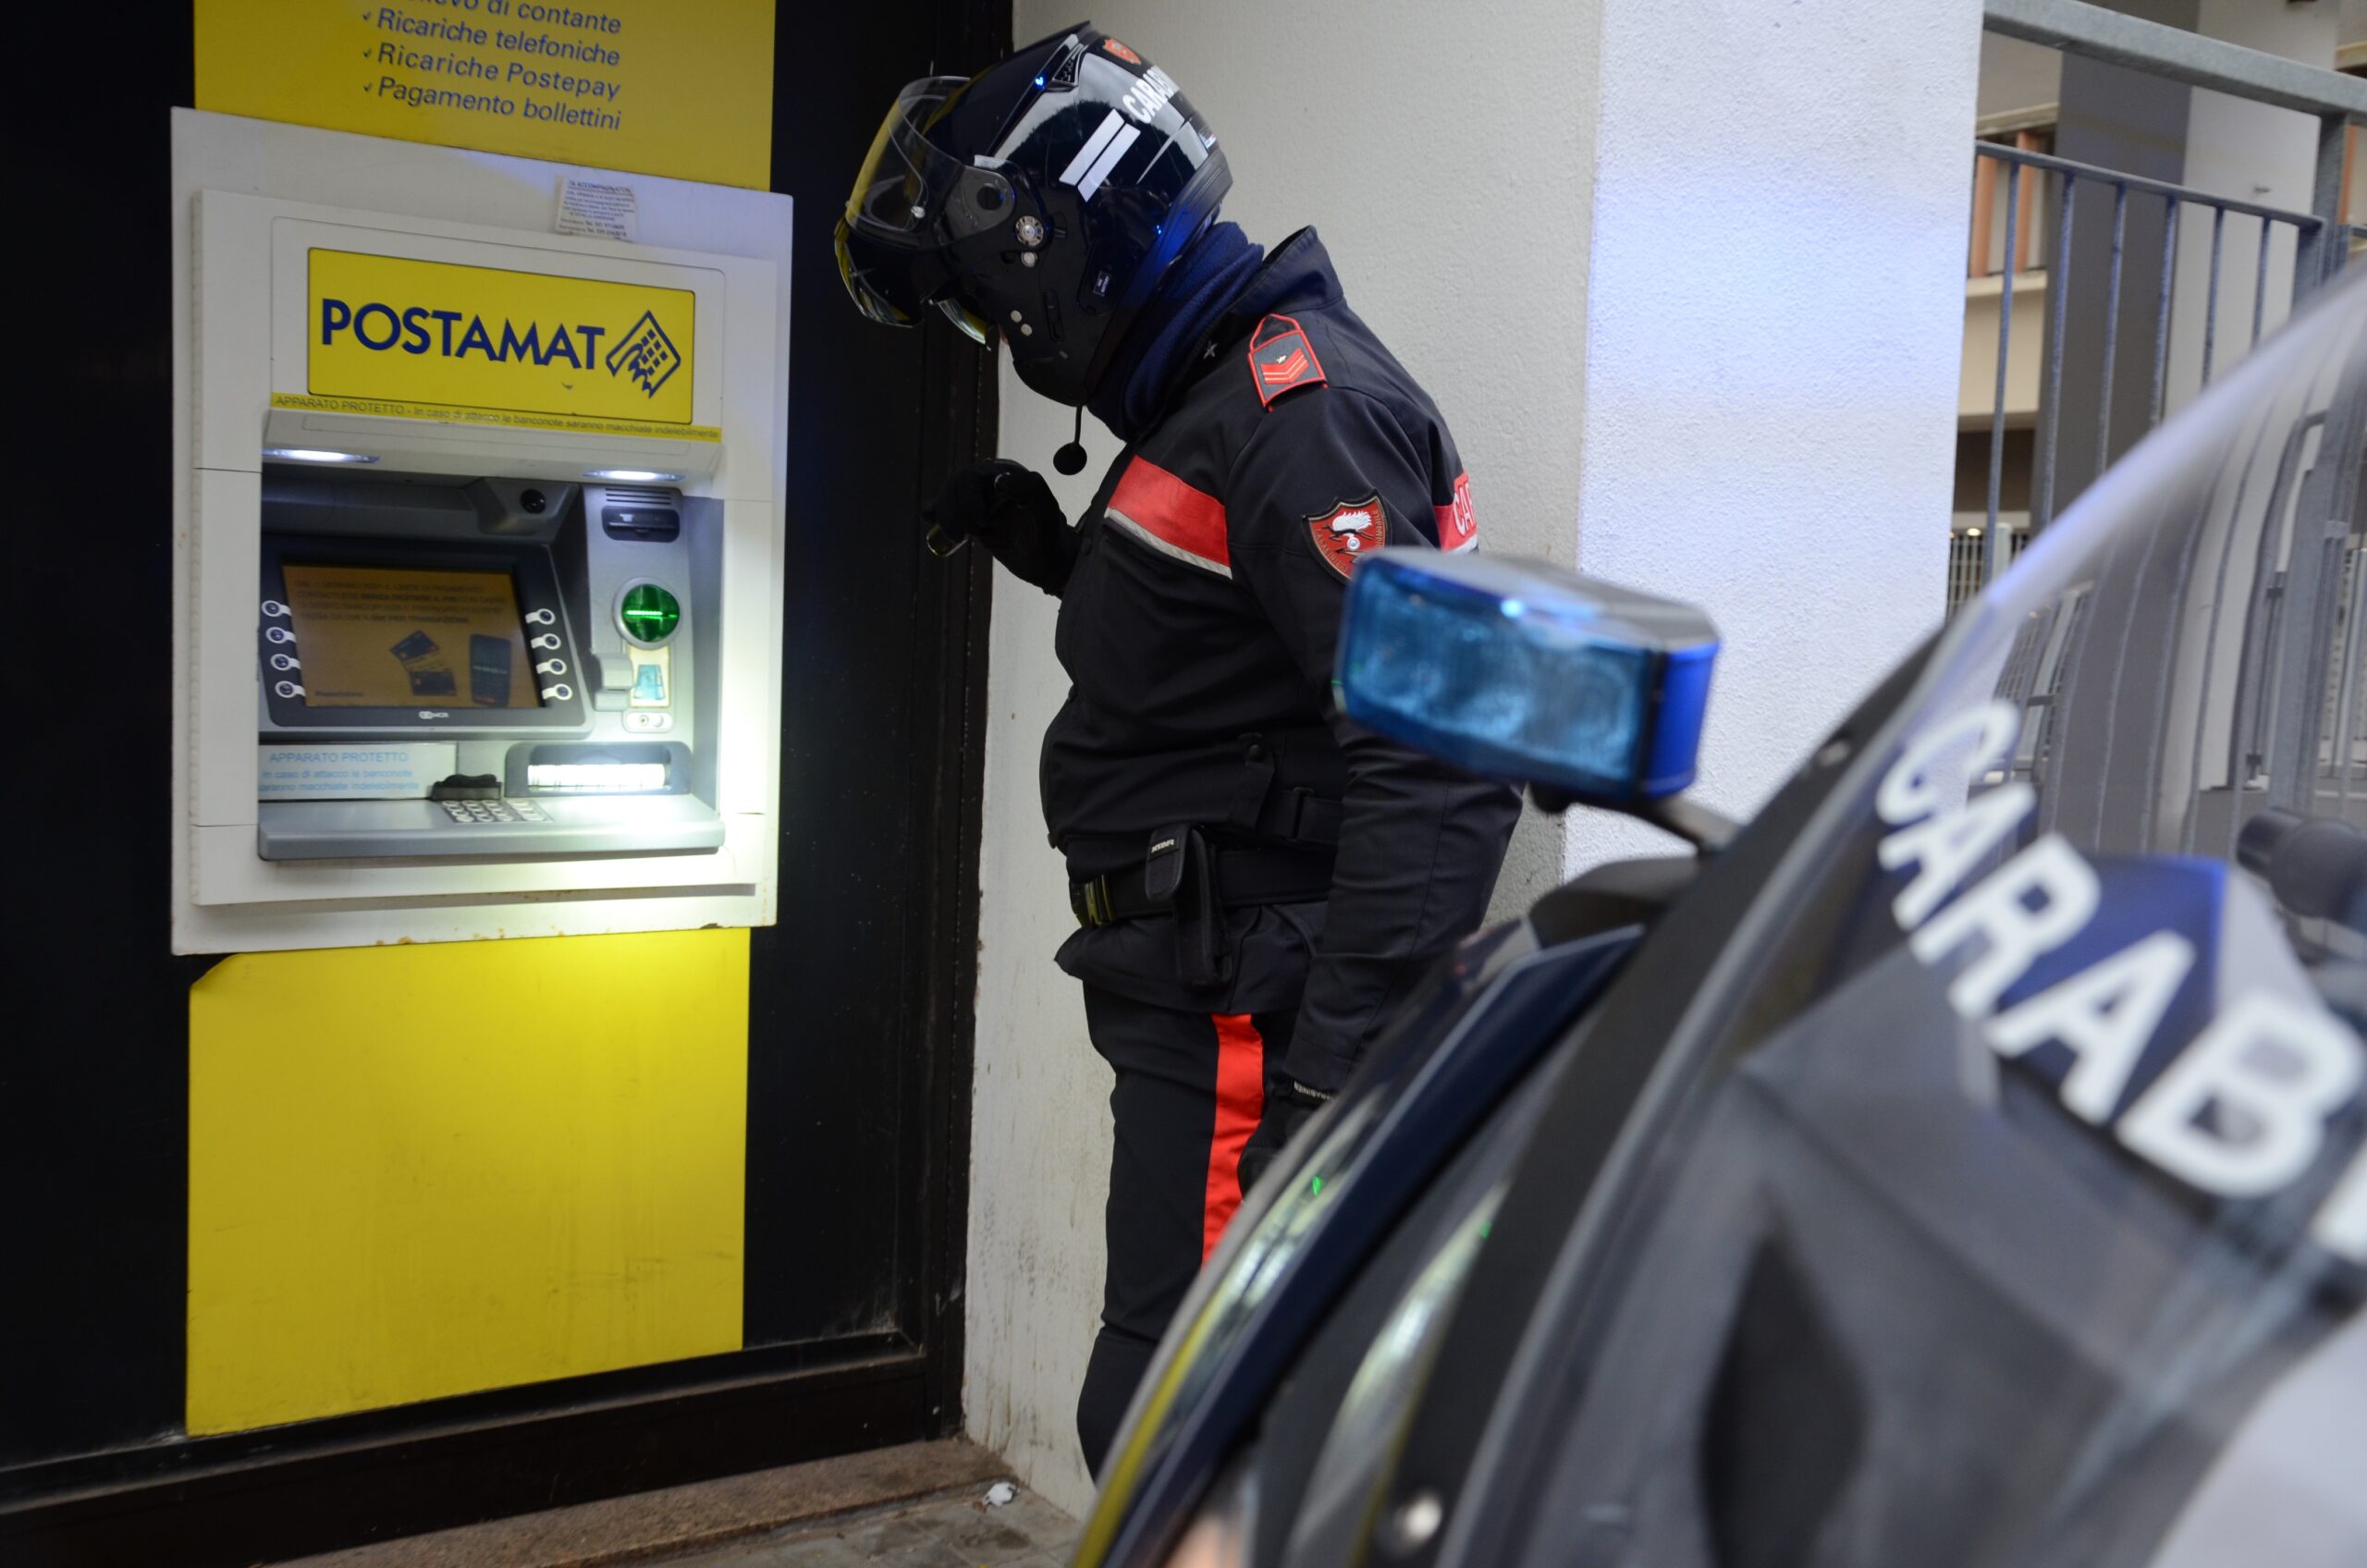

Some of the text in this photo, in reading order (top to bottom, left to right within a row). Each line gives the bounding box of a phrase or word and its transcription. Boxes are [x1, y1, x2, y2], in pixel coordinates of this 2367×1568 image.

[377, 7, 620, 67] Ricariche telefoniche
[518, 4, 621, 34] contante
[377, 42, 621, 102] Ricariche Postepay
[378, 76, 621, 130] Pagamento bollettini
[322, 298, 605, 370] POSTAMAT
[276, 397, 338, 410] APPARATO
[341, 403, 404, 416] PROTETTO
[414, 406, 423, 416] In
[427, 410, 450, 419] caso
[453, 410, 462, 420] di
[513, 415, 563, 427] banconote
[566, 420, 604, 430] saranno
[606, 423, 653, 434] macchiate
[655, 425, 719, 439] indelebilmente
[269, 752, 409, 763] APPARATO PROTETTO
[313, 770, 349, 778] attacco
[362, 769, 412, 778] banconote
